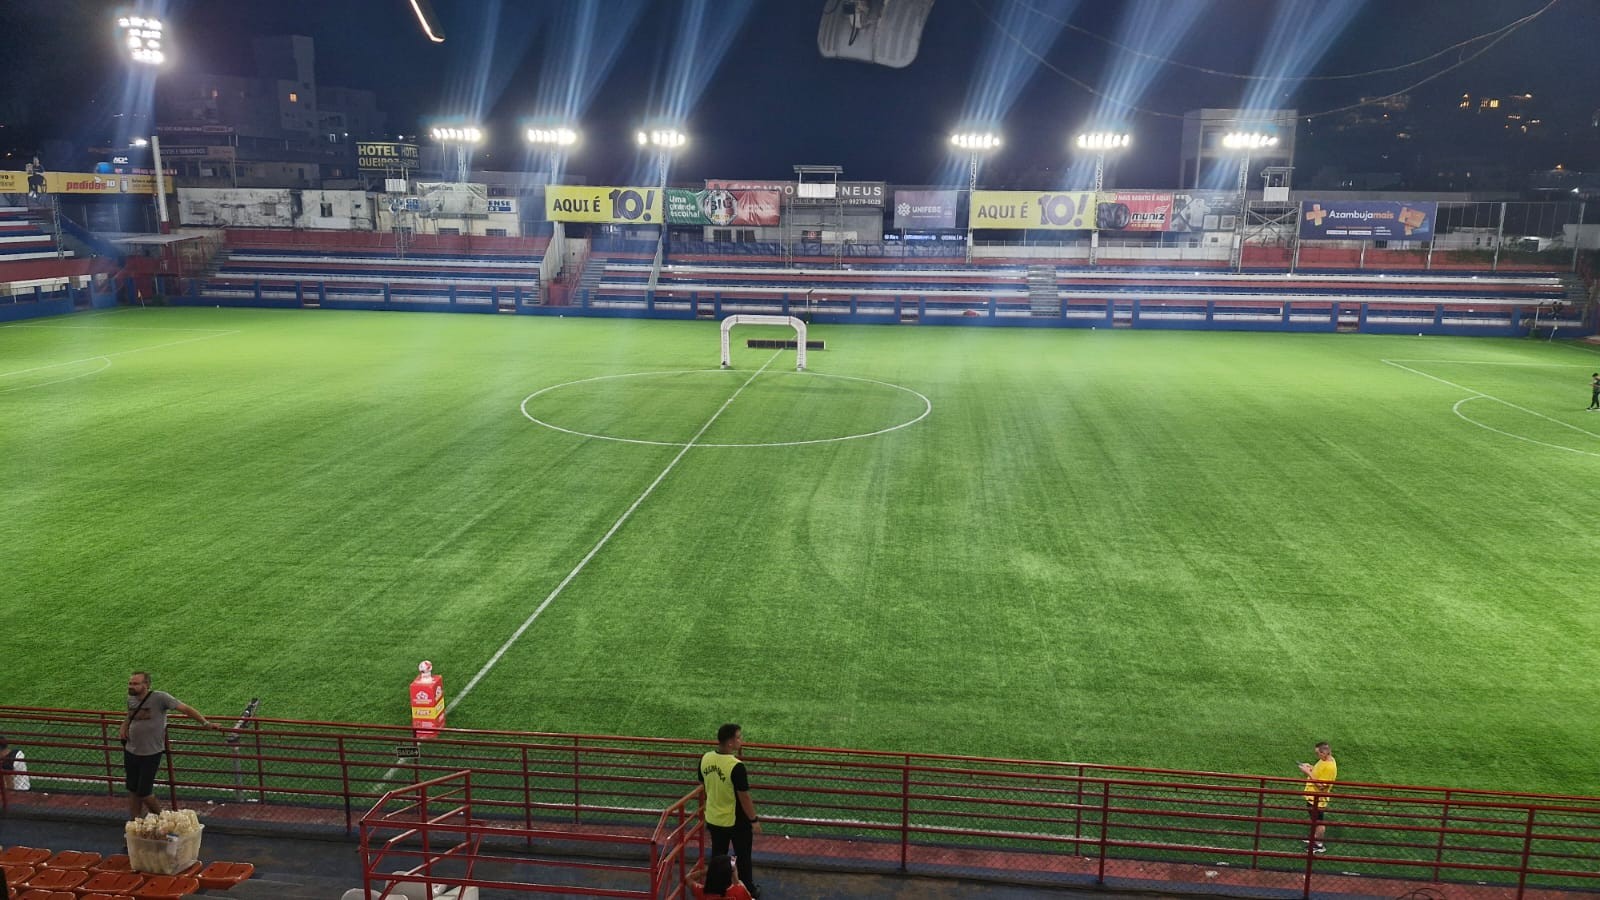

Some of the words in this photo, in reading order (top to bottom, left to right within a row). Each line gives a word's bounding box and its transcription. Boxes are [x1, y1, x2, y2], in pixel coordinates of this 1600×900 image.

[358, 144, 399, 156] HOTEL
[401, 146, 418, 158] HOTEL
[553, 198, 589, 212] AQUI
[593, 195, 601, 212] É
[608, 188, 655, 222] 10!
[669, 195, 686, 203] Uma
[669, 203, 696, 211] grande
[977, 205, 1016, 219] AQUI
[1020, 202, 1029, 219] É
[1038, 194, 1090, 228] 10!
[1132, 212, 1166, 221] muniz
[1328, 209, 1395, 222] Azambujamais
